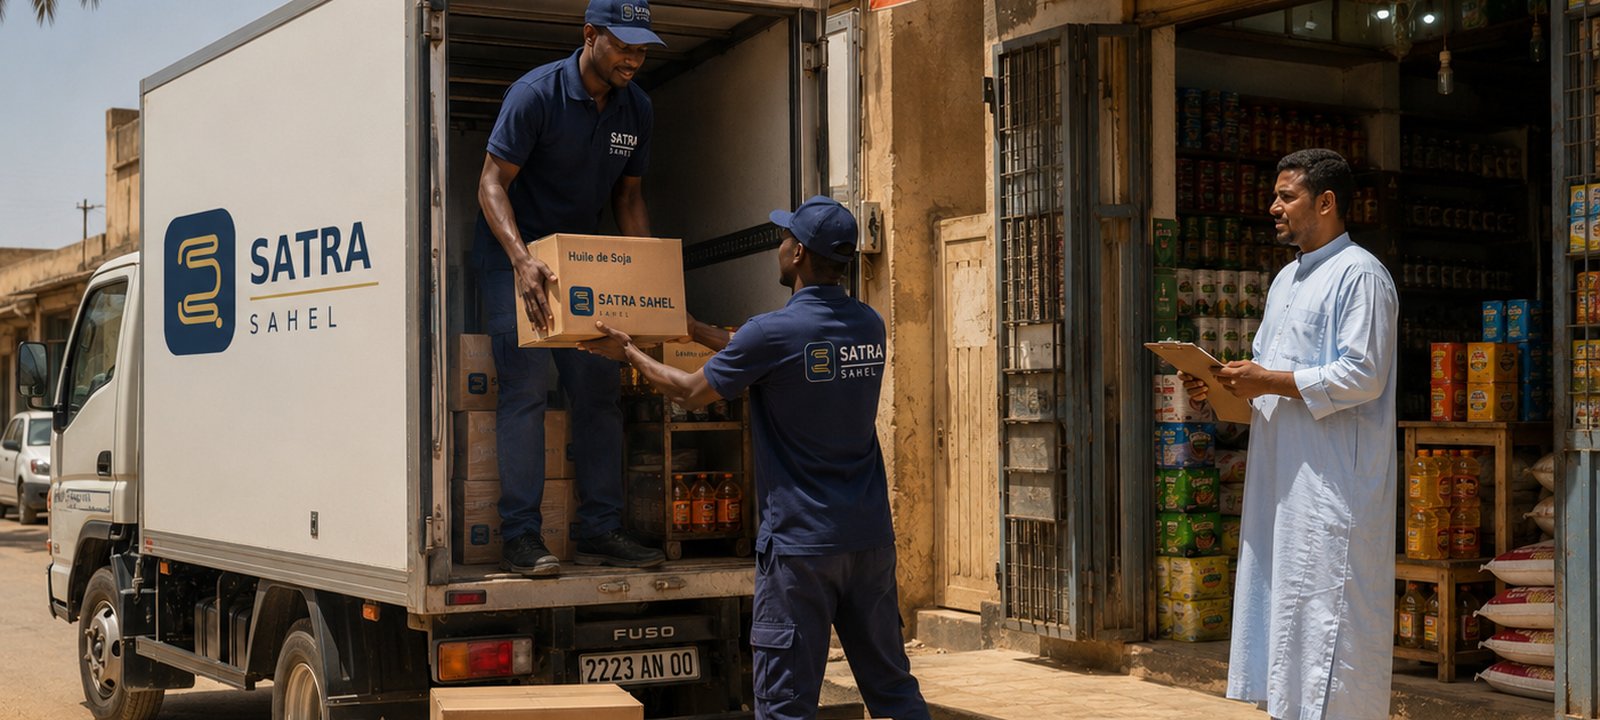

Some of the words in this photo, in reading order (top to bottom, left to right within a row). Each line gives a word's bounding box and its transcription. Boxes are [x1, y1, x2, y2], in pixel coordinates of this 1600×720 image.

[610, 131, 638, 146] SATRA
[250, 221, 371, 285] SATRA
[568, 251, 594, 262] Huile
[596, 252, 608, 263] de
[611, 253, 632, 265] Soja
[598, 293, 637, 307] SATRA
[639, 296, 675, 309] SAHEL
[250, 305, 337, 334] SAHEL
[840, 343, 884, 362] SATRA
[841, 367, 876, 379] SAHEL
[613, 626, 674, 641] FUSO
[585, 656, 634, 683] 2223
[641, 654, 664, 679] AN
